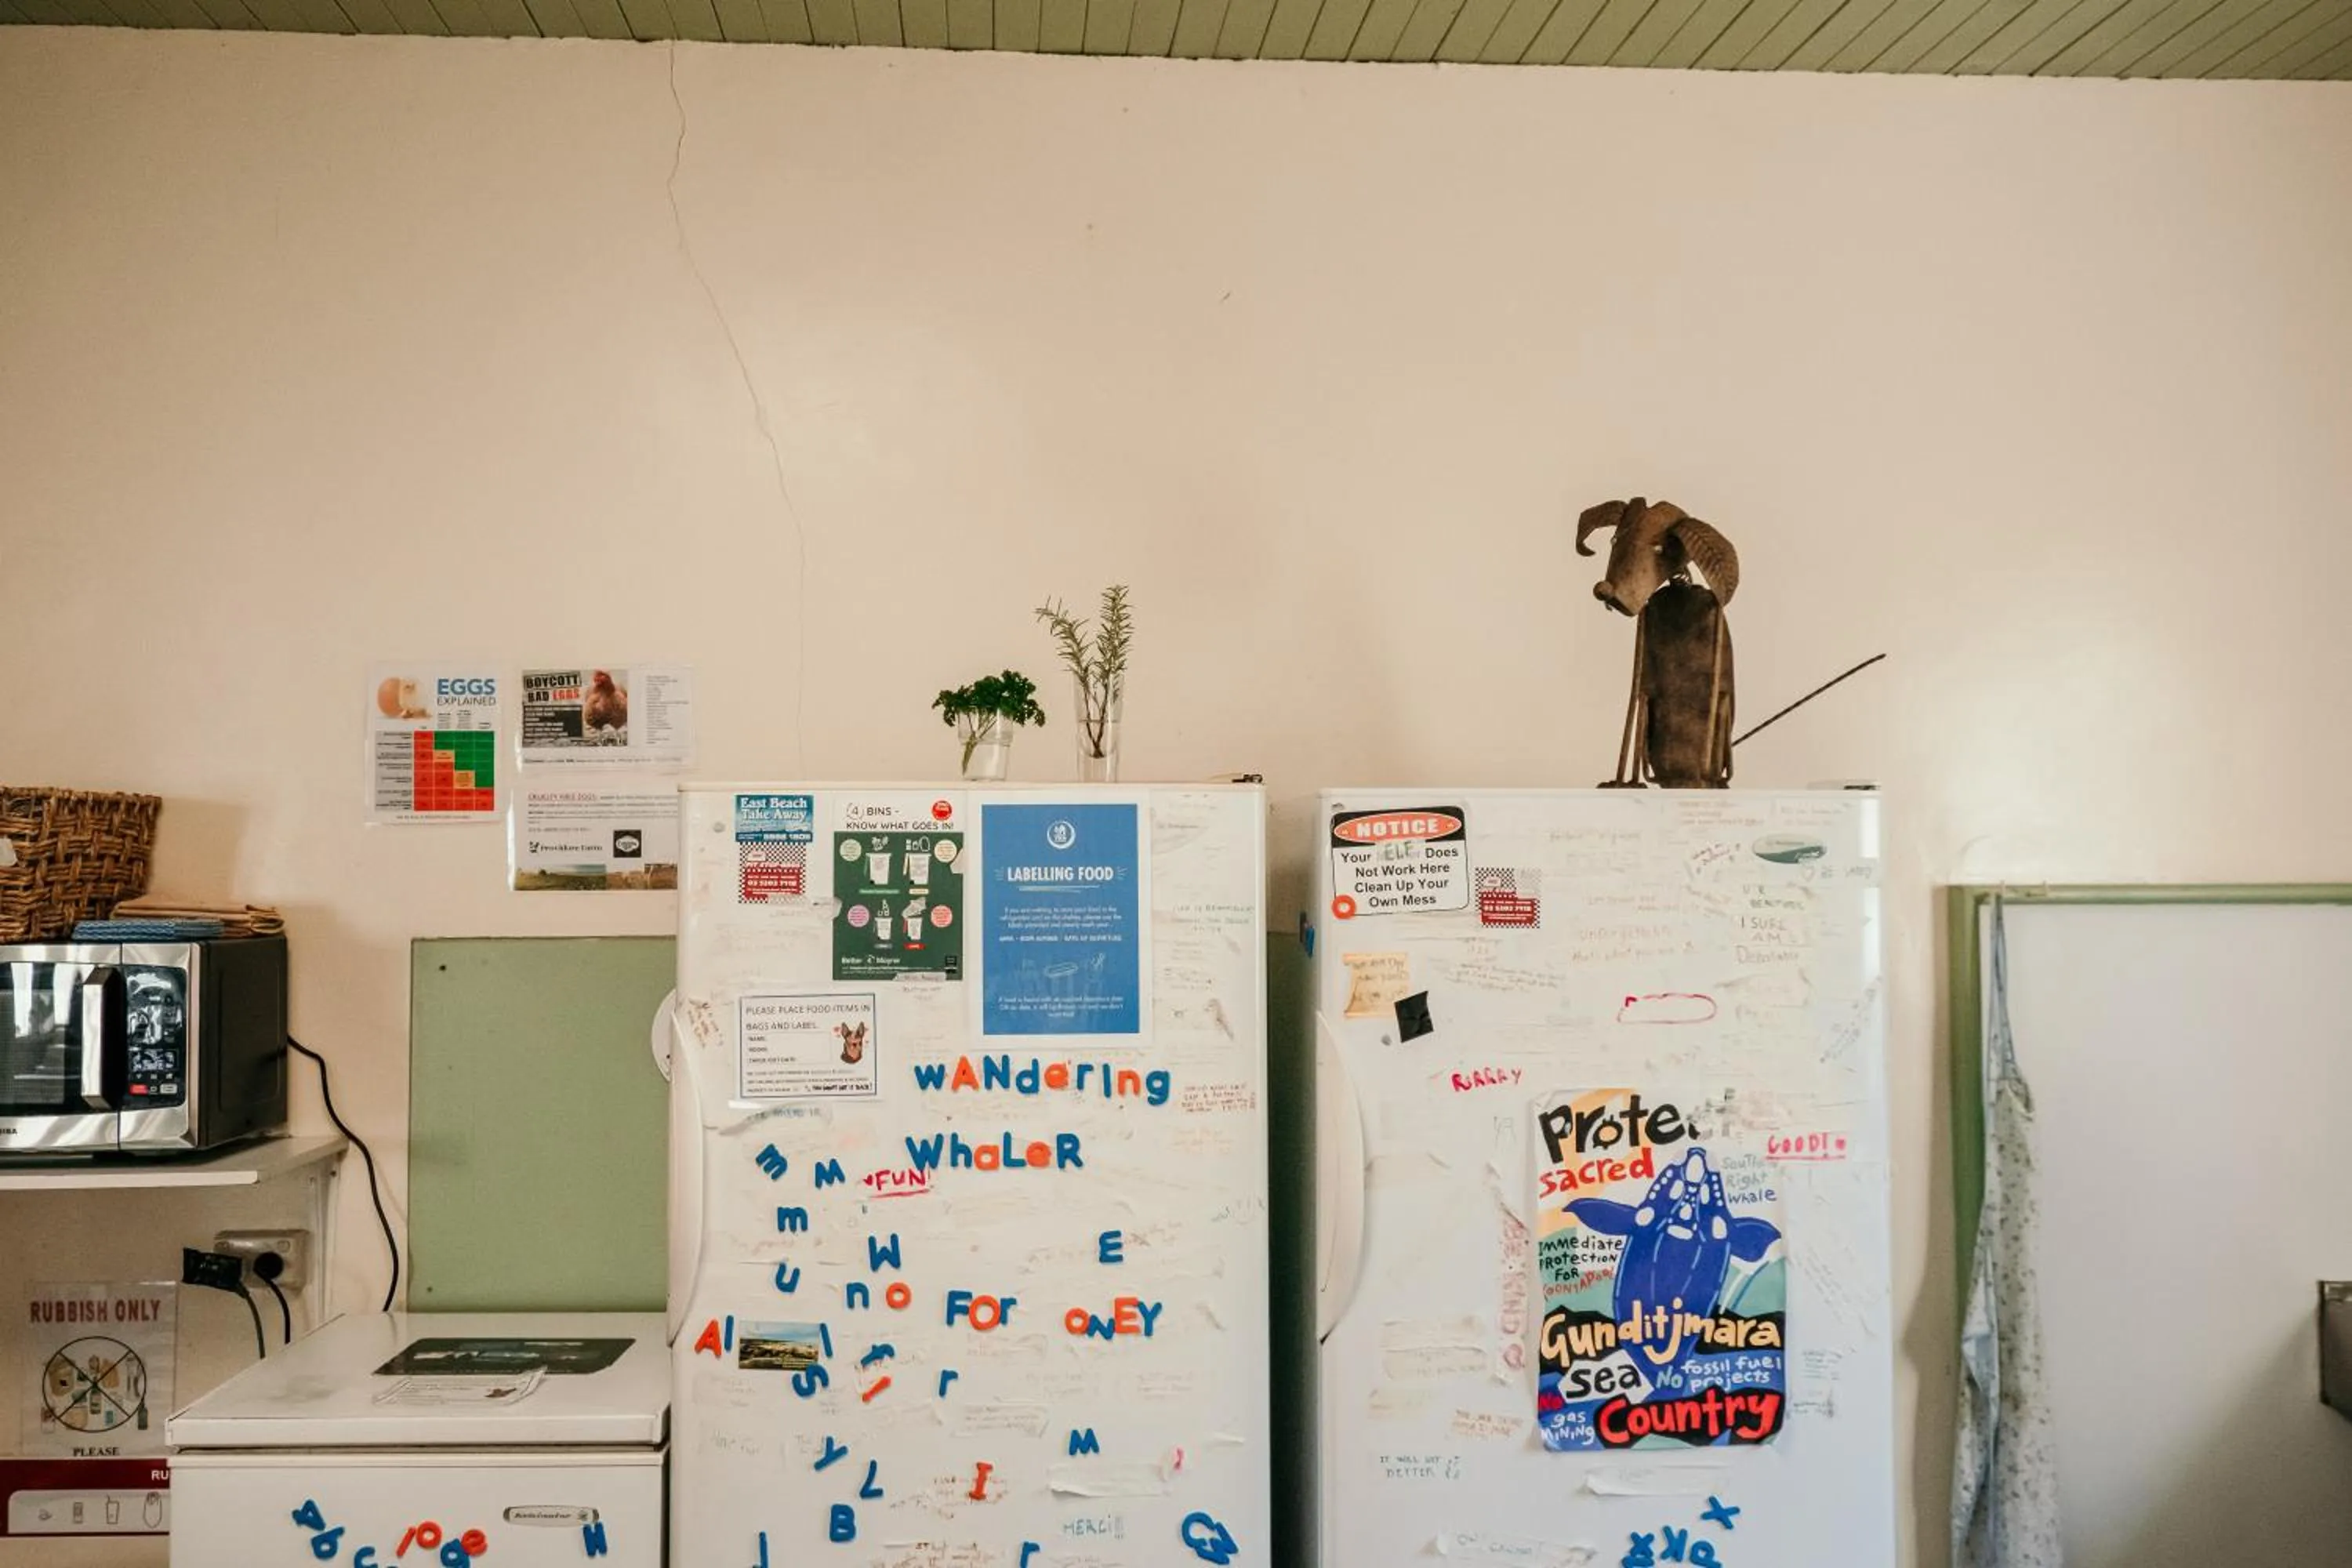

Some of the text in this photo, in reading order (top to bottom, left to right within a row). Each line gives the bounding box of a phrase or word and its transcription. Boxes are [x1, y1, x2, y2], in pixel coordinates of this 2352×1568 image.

[437, 678, 495, 695] EGGS
[526, 673, 579, 689] BOYCOTT
[437, 695, 496, 706] EXPLAINED
[740, 797, 808, 808] East Beach
[866, 807, 891, 815] BINS
[742, 808, 807, 822] Take Away
[1356, 818, 1439, 838] NOTICE
[1341, 852, 1372, 863] Your
[1425, 846, 1459, 858] Does
[1007, 866, 1114, 881] LABELLING FOOD
[1356, 862, 1450, 878] Not Work Here
[1355, 877, 1449, 893] Clean Up Your
[1369, 894, 1437, 907] Own Mess
[746, 1006, 775, 1014] PLEASE
[779, 1005, 804, 1014] PLACE
[807, 1004, 831, 1013] FOOD
[1539, 1147, 1655, 1199] sacred
[1099, 1230, 1124, 1264] E
[30, 1299, 162, 1323] RUBBISH ONLY
[1541, 1298, 1781, 1367] Gunditjmara
[1682, 1360, 1730, 1377] fossil
[1735, 1356, 1782, 1370] fuel
[1691, 1371, 1770, 1392] projects
[1550, 1411, 1586, 1428] gas
[1599, 1388, 1780, 1444] Country
[72, 1446, 121, 1457] PLEASE
[829, 1504, 856, 1543] B
